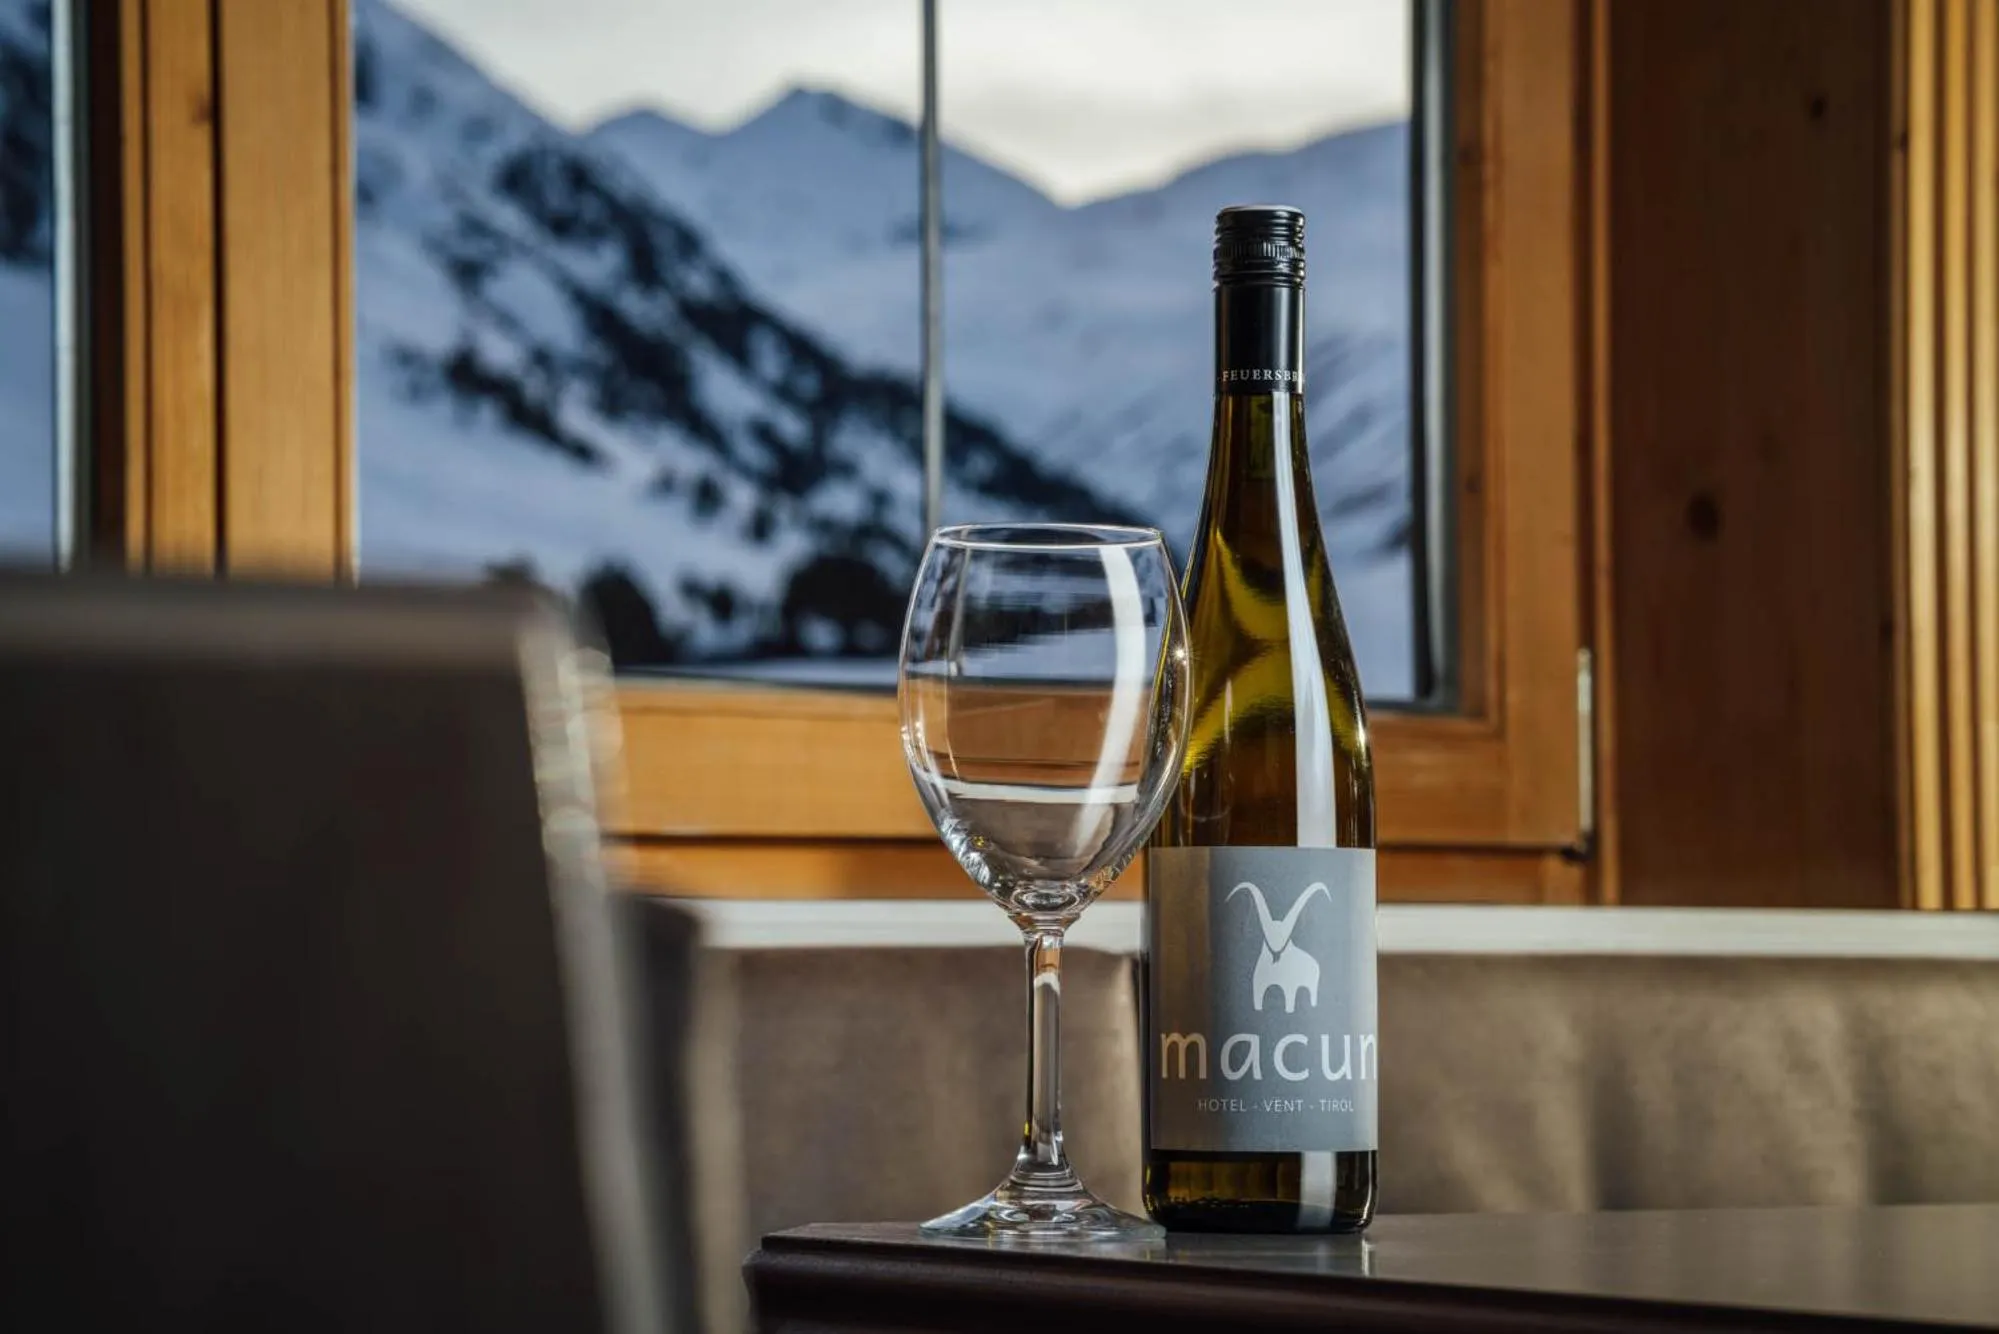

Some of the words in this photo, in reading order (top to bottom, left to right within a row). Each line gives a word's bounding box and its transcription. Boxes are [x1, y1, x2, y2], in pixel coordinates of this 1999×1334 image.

[1222, 368, 1303, 382] FEUERSBR
[1197, 1098, 1247, 1112] HOTEL
[1263, 1098, 1304, 1112] VENT
[1318, 1098, 1354, 1112] TIROL
